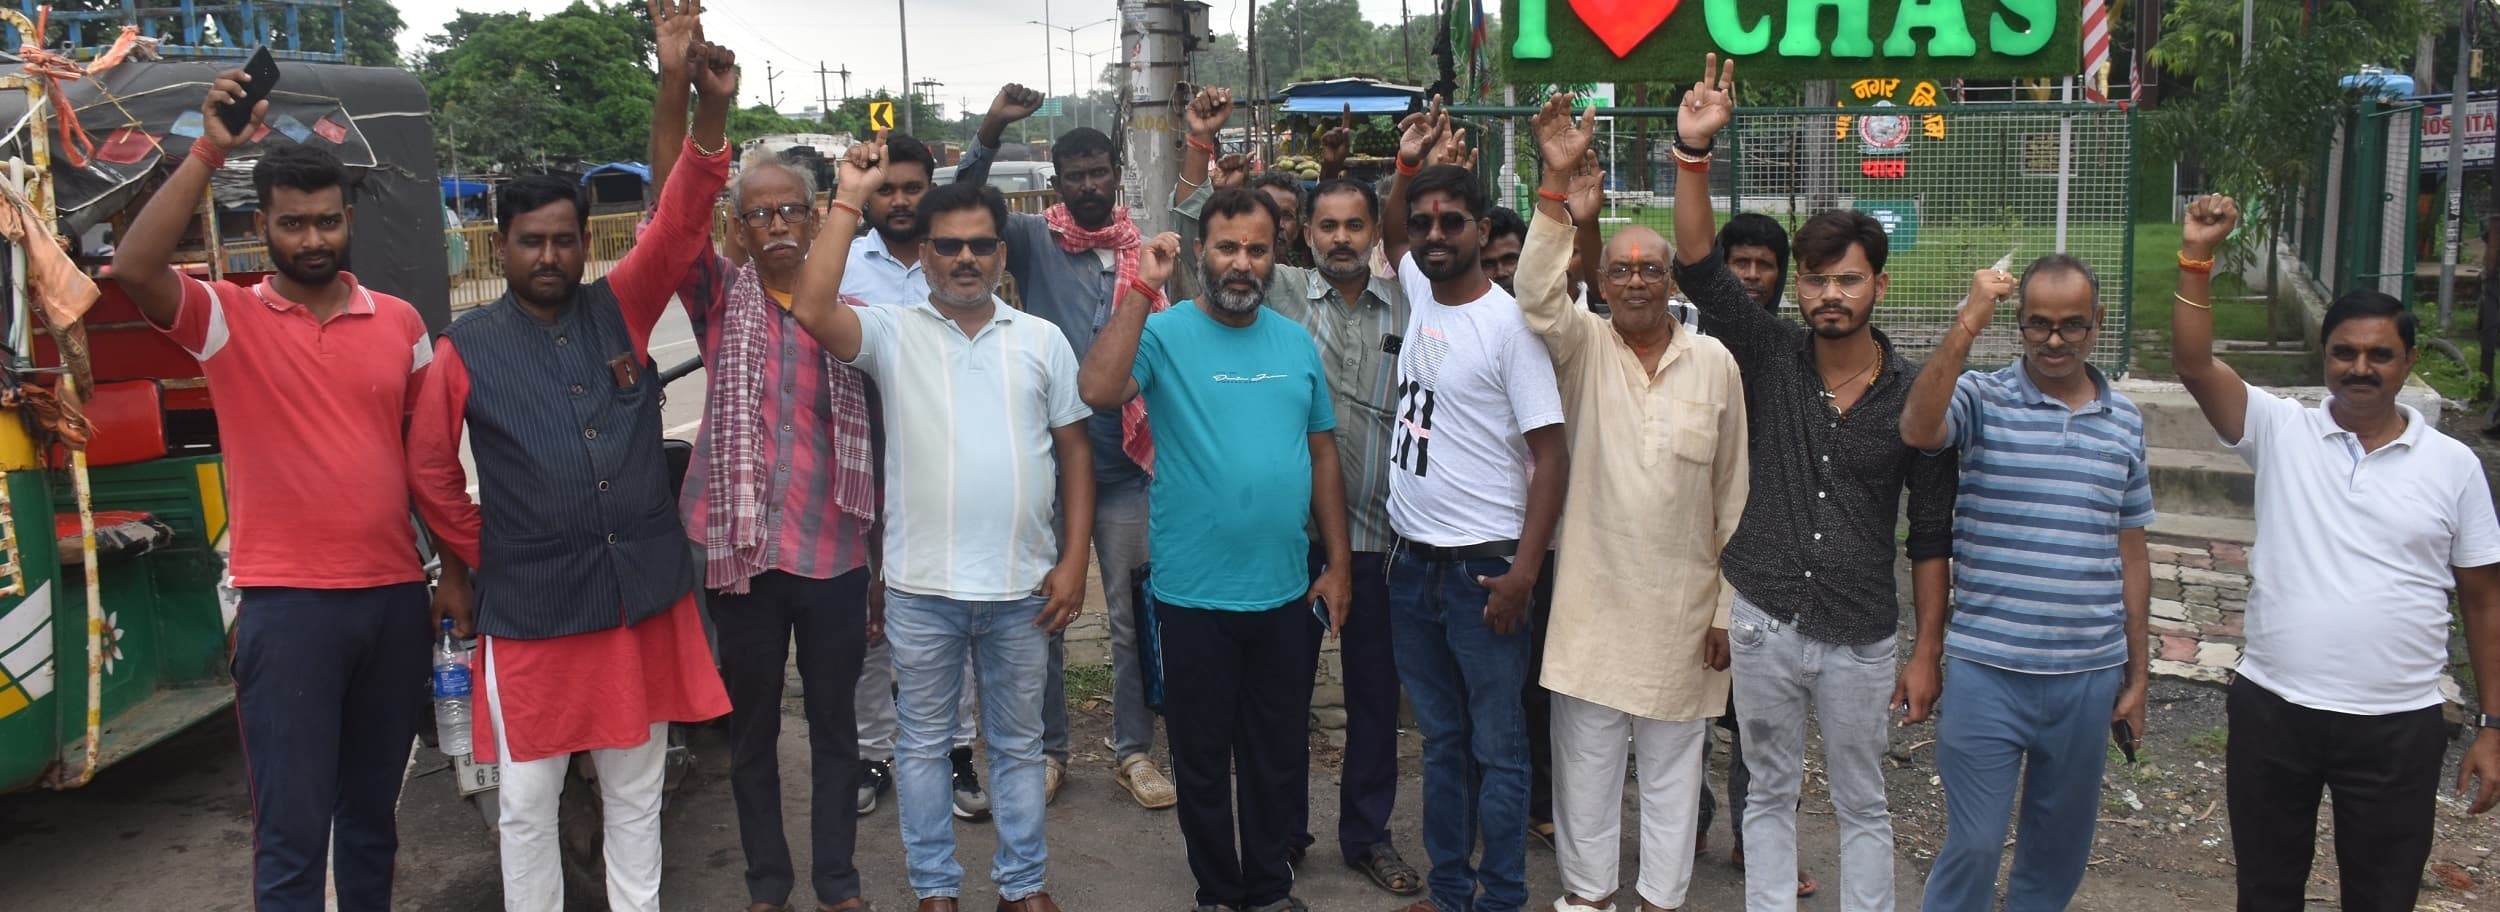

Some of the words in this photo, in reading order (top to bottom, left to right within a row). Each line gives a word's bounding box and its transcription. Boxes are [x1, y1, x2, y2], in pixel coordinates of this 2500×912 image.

[1704, 0, 2058, 58] CHAS
[1850, 78, 1901, 99] नगर
[2422, 112, 2495, 136] HOSITA
[476, 765, 500, 786] 65
